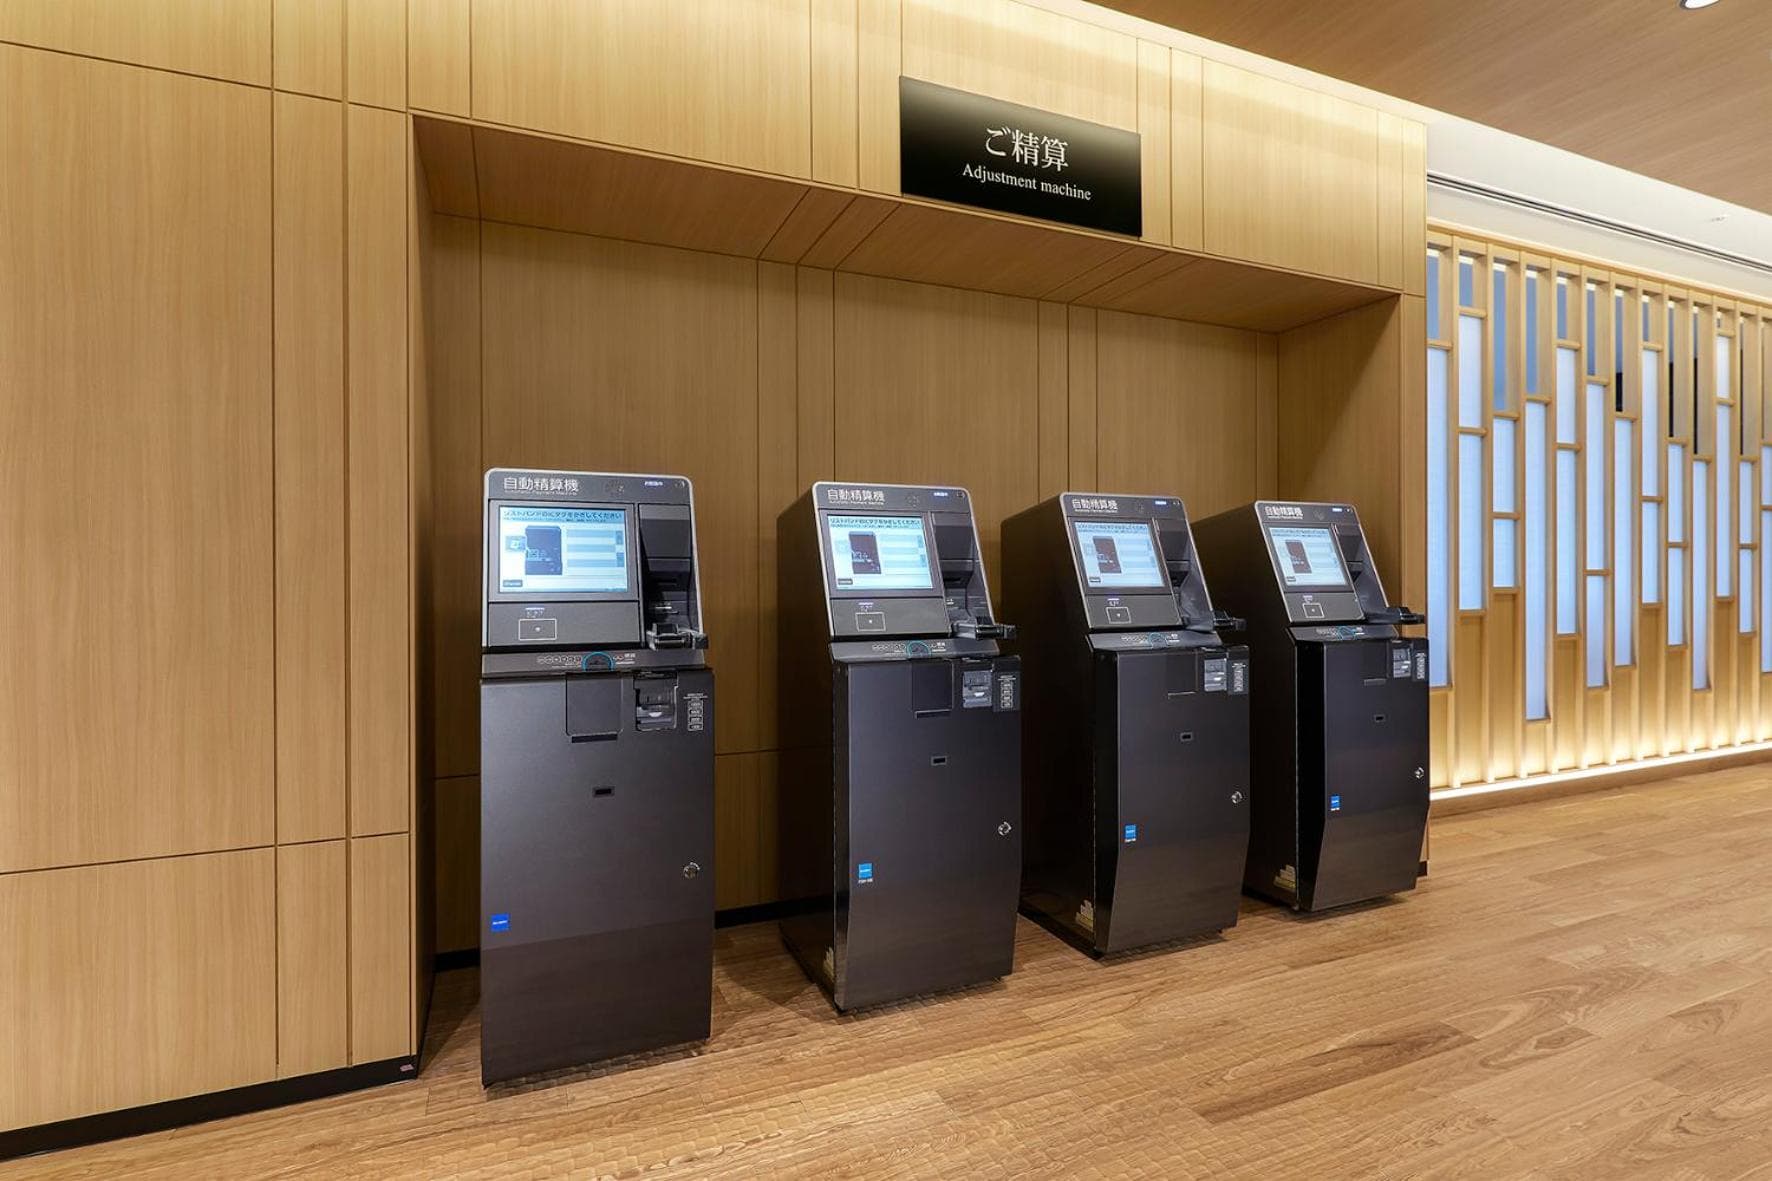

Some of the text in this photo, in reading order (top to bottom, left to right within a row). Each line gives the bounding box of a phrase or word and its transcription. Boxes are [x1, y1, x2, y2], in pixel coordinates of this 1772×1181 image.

[985, 127, 1069, 172] ご精算
[962, 163, 1092, 201] Adjustment machine
[503, 477, 579, 492] 自動精算機
[827, 489, 885, 502] 自動精算機
